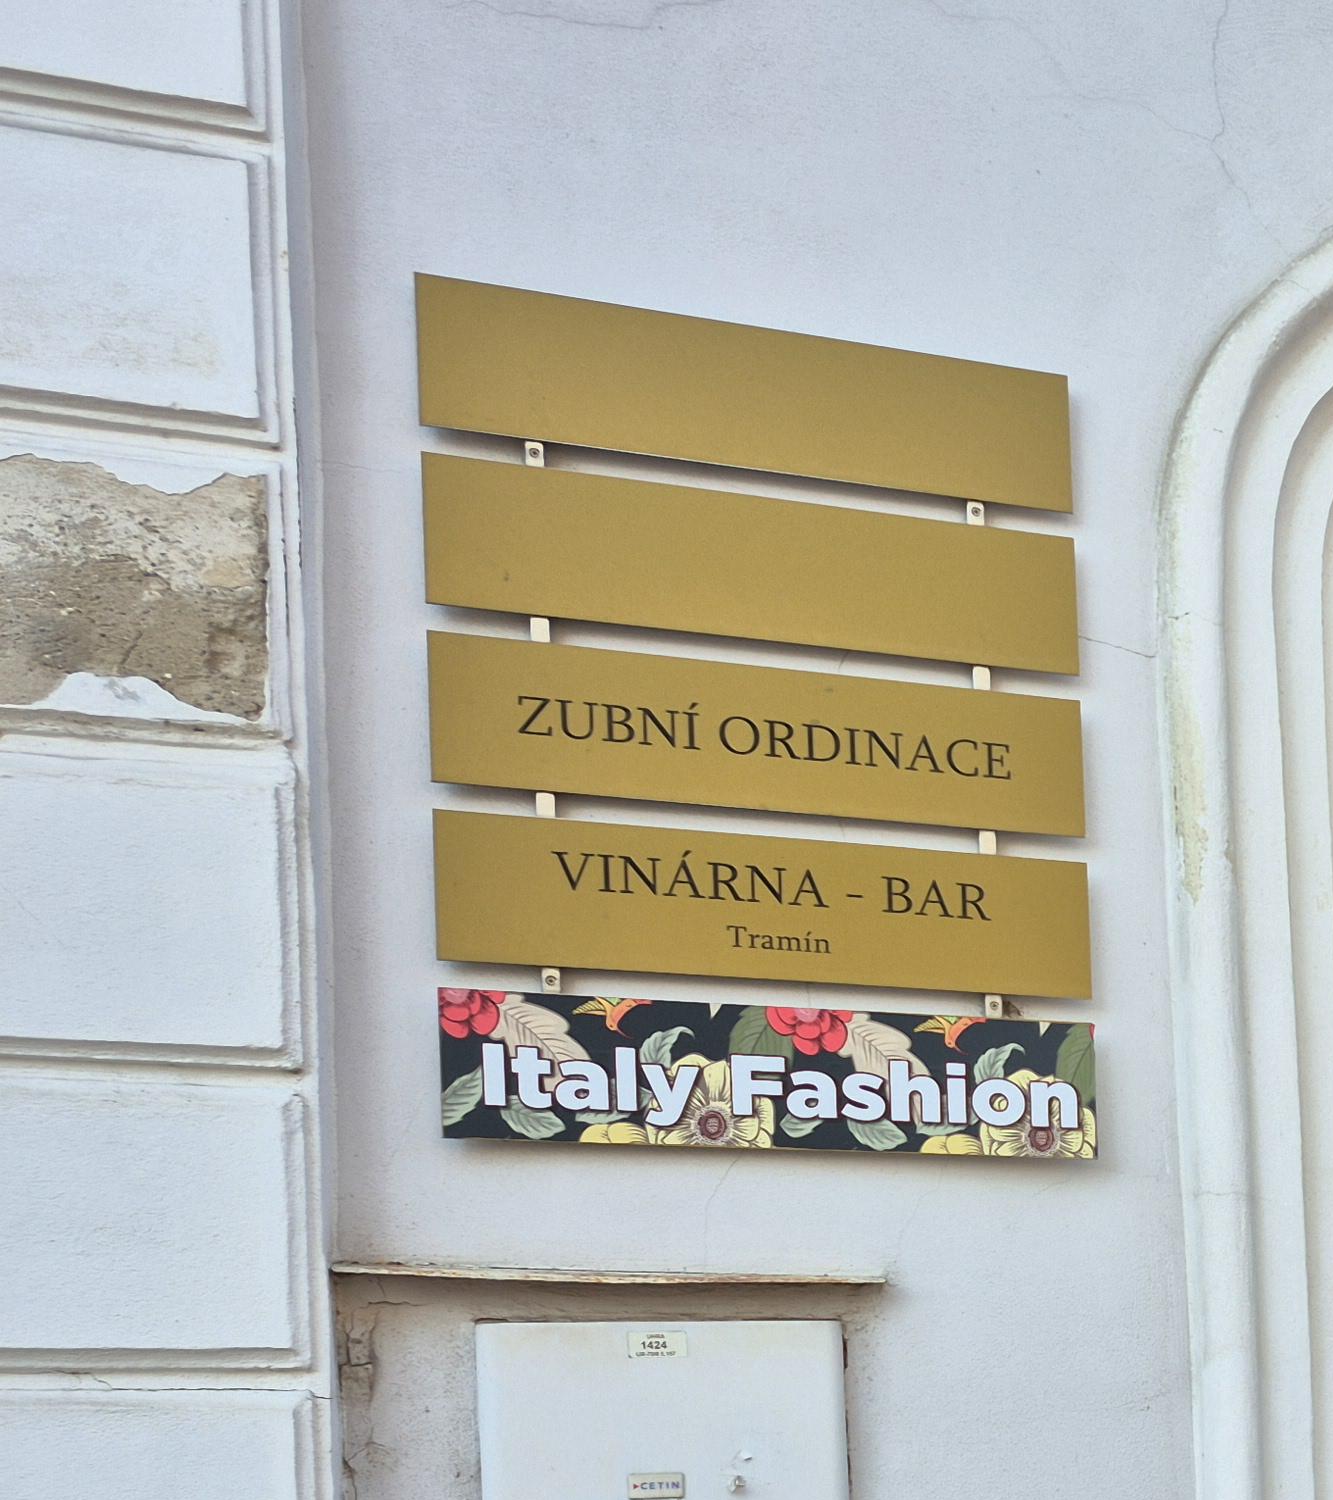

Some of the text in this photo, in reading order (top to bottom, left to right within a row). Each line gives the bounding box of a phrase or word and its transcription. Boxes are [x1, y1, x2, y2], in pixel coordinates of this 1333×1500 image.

[516, 694, 1013, 781] ZUBNÍ ORDINACE
[552, 850, 830, 909] VINÁRNA
[882, 876, 992, 922] BAR
[726, 925, 831, 954] Tramín
[480, 1042, 1081, 1130] Italy Fashion
[641, 1341, 667, 1349] 1424
[640, 1481, 681, 1490] CETIN
